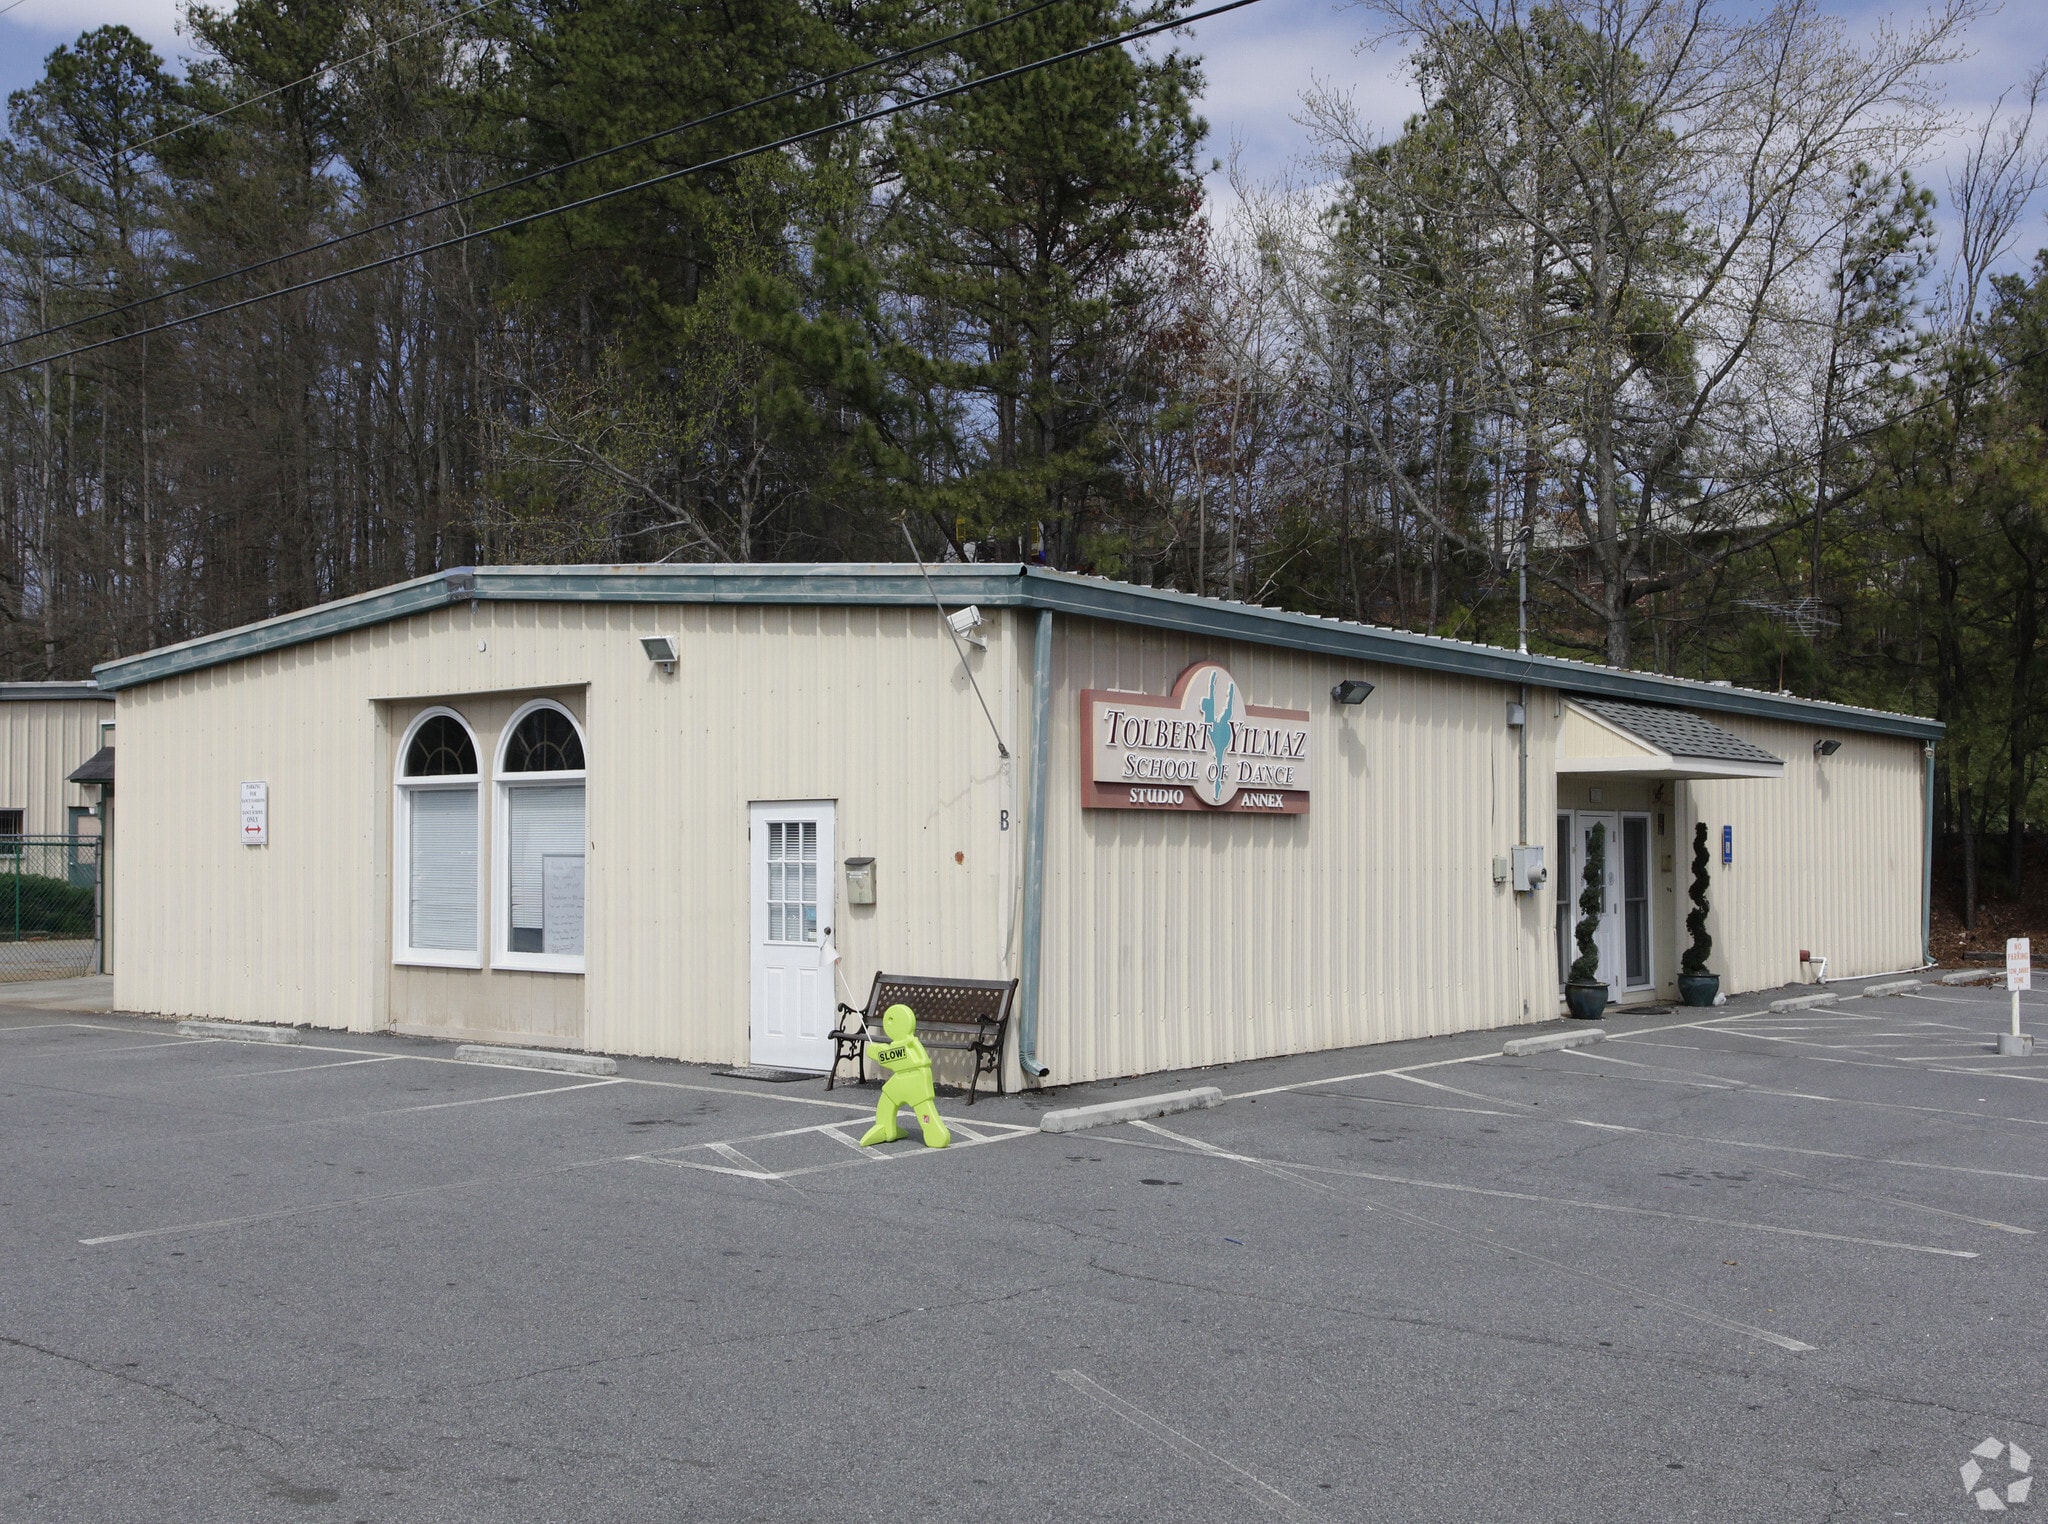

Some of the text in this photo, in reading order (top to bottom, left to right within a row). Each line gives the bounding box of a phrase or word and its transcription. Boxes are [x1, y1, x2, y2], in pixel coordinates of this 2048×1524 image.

[1104, 708, 1307, 759] TOLBERT YILMAZ
[1123, 752, 1295, 785] SCHOOL OF DANCE
[1129, 788, 1284, 808] STUDIO ANNEX
[1000, 809, 1009, 831] B
[2013, 943, 2022, 951] NO
[880, 1048, 906, 1062] SLOW!
